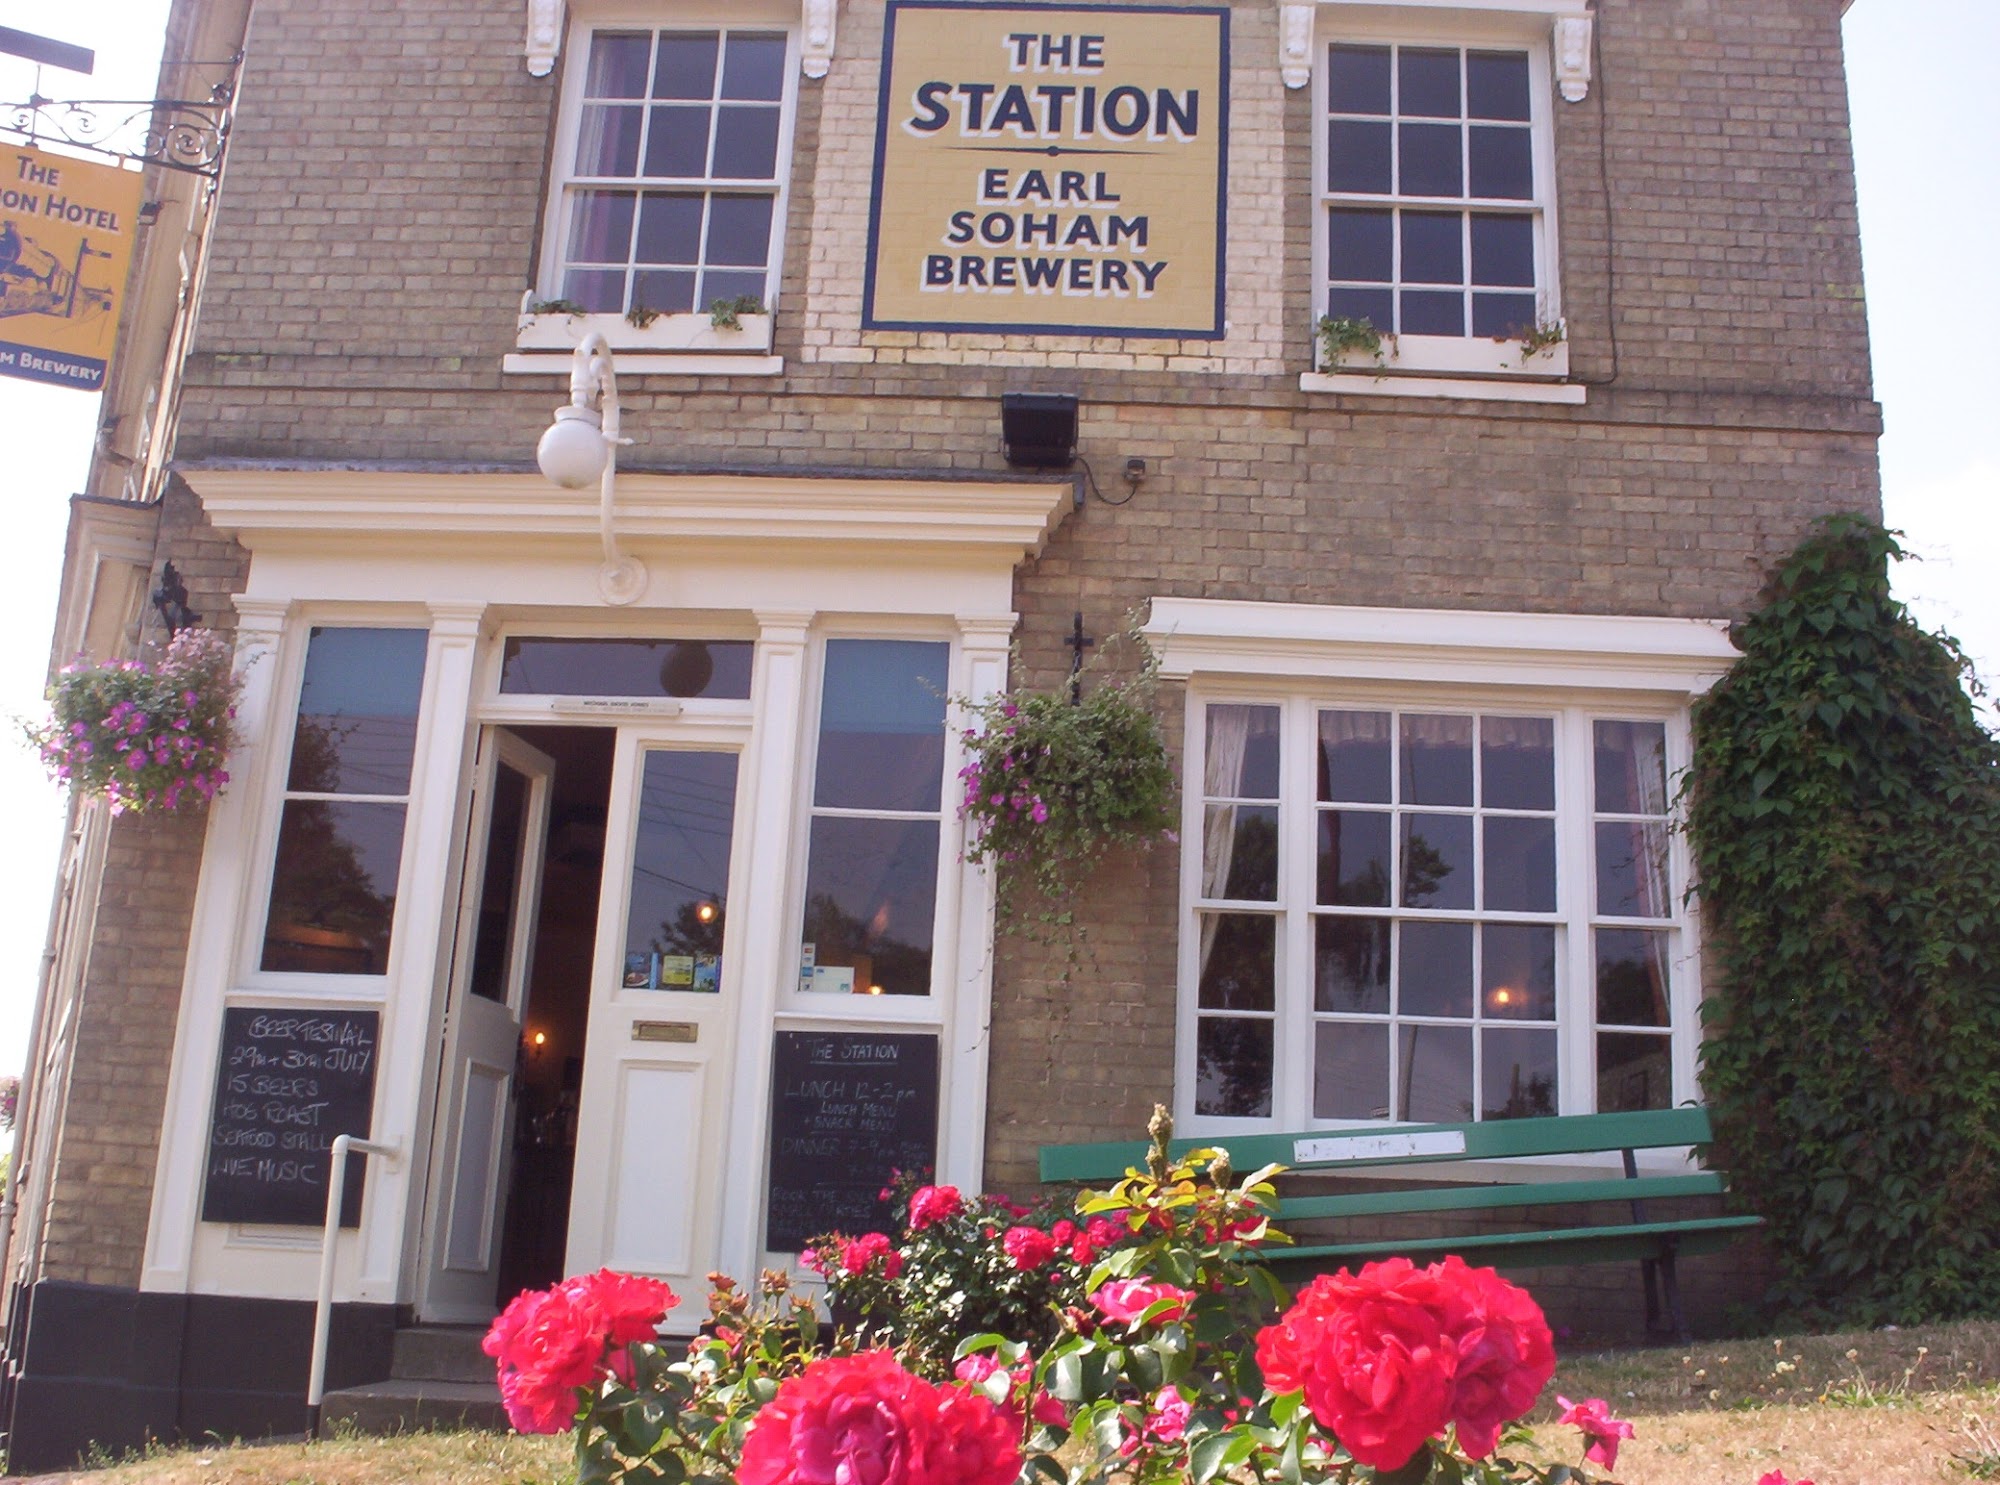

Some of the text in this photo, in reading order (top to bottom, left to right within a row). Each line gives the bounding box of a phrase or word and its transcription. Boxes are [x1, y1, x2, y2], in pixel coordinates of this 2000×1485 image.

[1003, 33, 1105, 73] THE
[903, 82, 1199, 142] STATION
[17, 155, 61, 188] THE
[977, 168, 1121, 208] EARL
[45, 194, 121, 236] HOTEL
[942, 211, 1148, 253] SOHAM
[920, 255, 1168, 298] BREWERY
[20, 351, 101, 381] BREWERY
[250, 1016, 372, 1045] BEER FESTIVAL
[325, 1048, 371, 1074] JULY
[807, 1037, 900, 1060] THE STATION
[228, 1073, 318, 1098] 15 BEERS
[785, 1077, 846, 1099] LUNCH
[223, 1101, 329, 1126] HOG ROAST
[814, 1116, 853, 1130] SNACK
[821, 1101, 897, 1118] LUNCH MENU
[212, 1125, 333, 1151] SEAFOOD STALL
[212, 1156, 319, 1184] LIVE MUSIC
